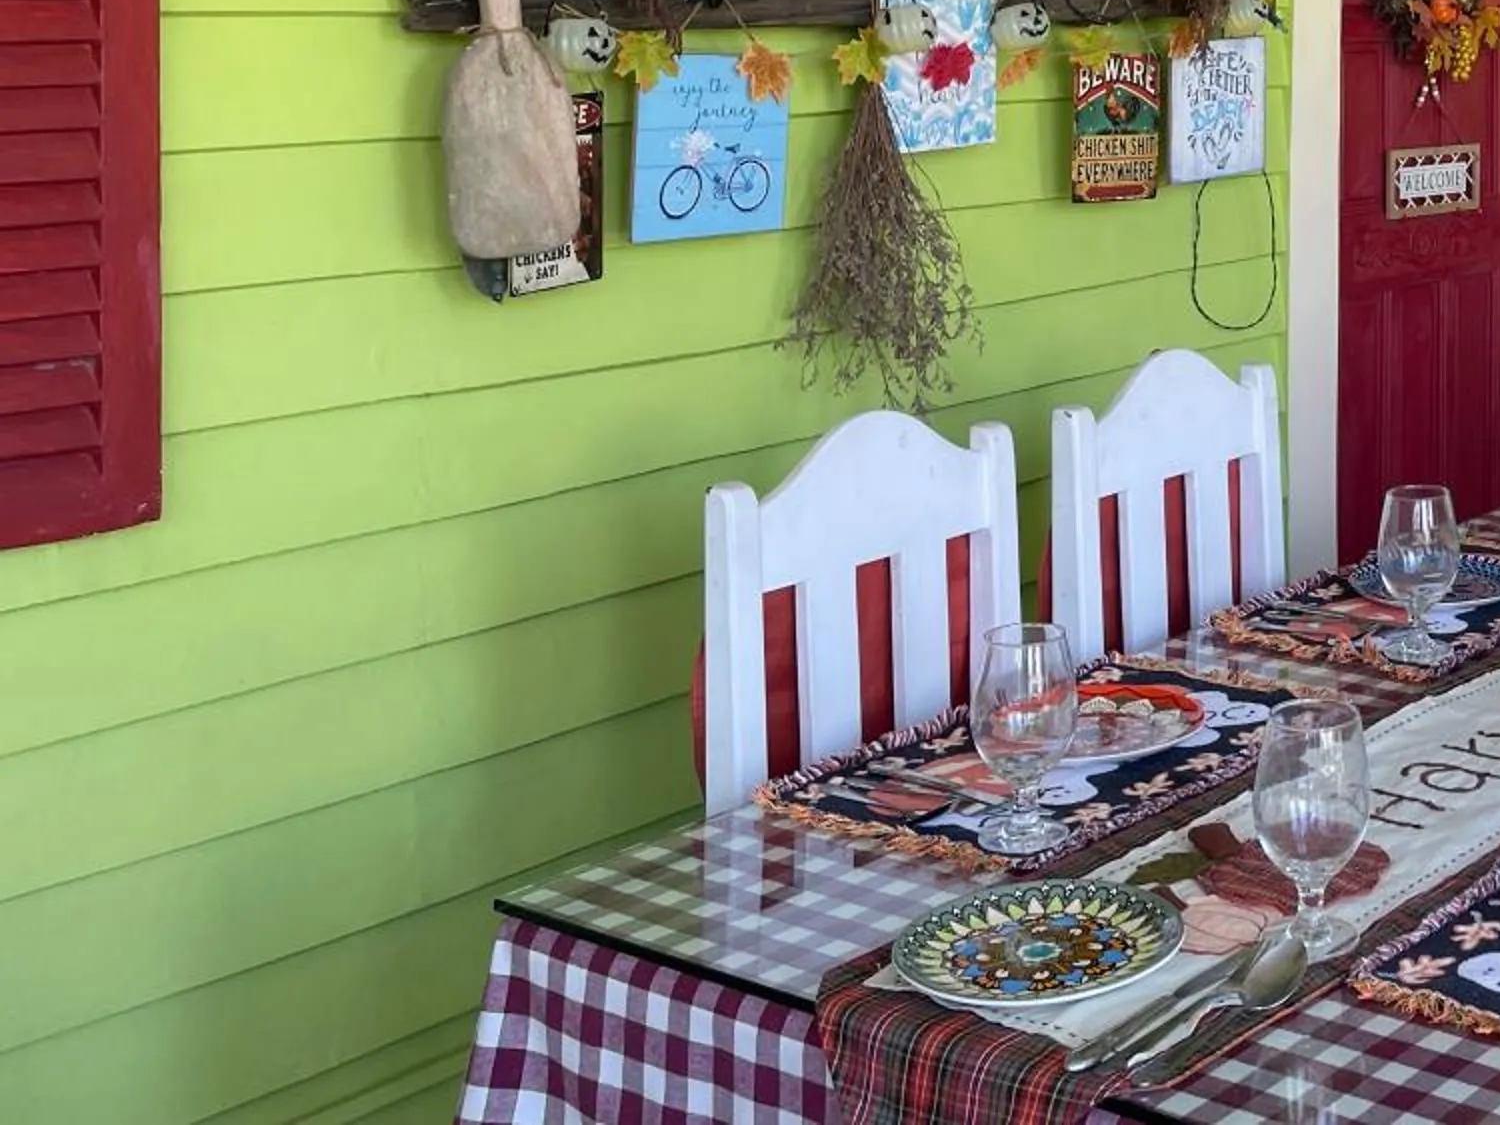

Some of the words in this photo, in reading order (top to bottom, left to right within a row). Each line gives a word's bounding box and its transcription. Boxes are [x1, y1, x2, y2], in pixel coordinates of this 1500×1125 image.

[1077, 57, 1156, 99] BEWARE
[1077, 137, 1127, 158] CHICKEN
[1129, 136, 1156, 156] SHIT
[1076, 160, 1154, 184] EVERYWHERE
[1404, 169, 1463, 192] WELCOME
[515, 244, 571, 267] CHICKENS
